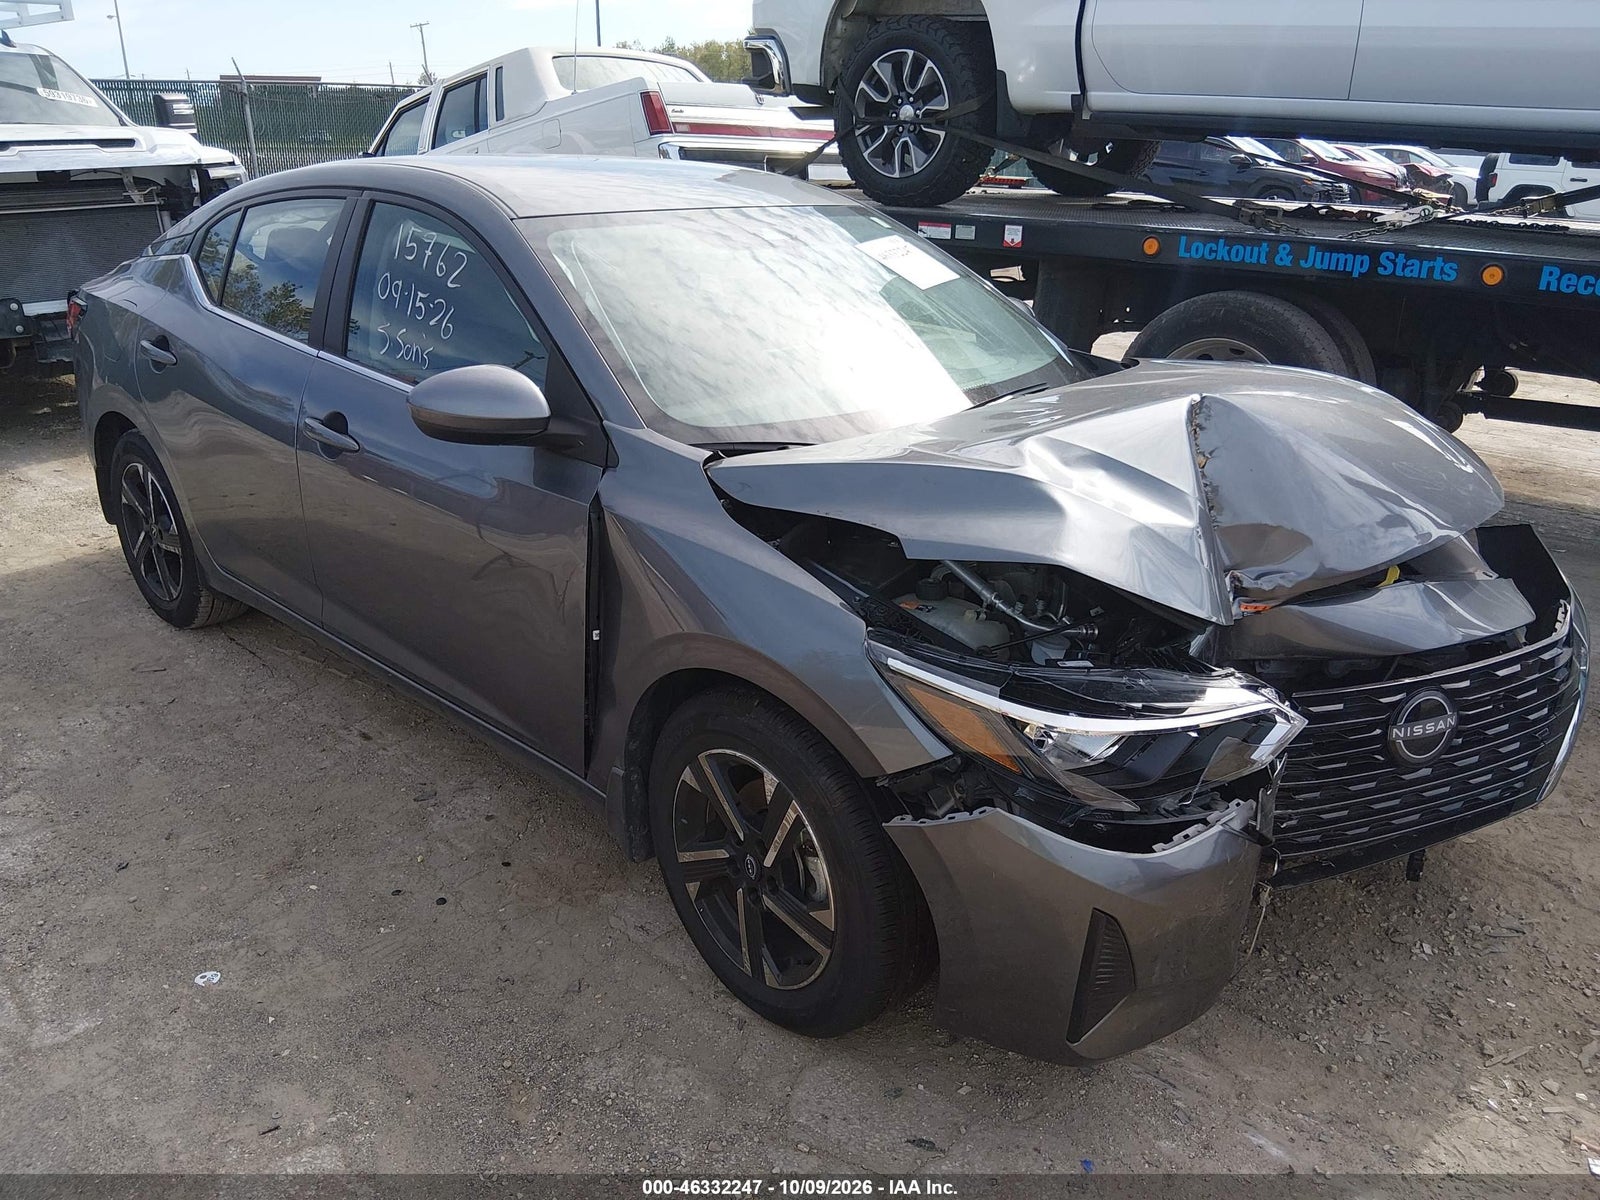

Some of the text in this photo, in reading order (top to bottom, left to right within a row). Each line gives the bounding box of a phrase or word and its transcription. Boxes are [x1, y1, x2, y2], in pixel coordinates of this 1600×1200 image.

[394, 223, 468, 288] 15762
[1178, 235, 1459, 282] Lockout & Jump Starts
[1392, 715, 1456, 738] NISSAN
